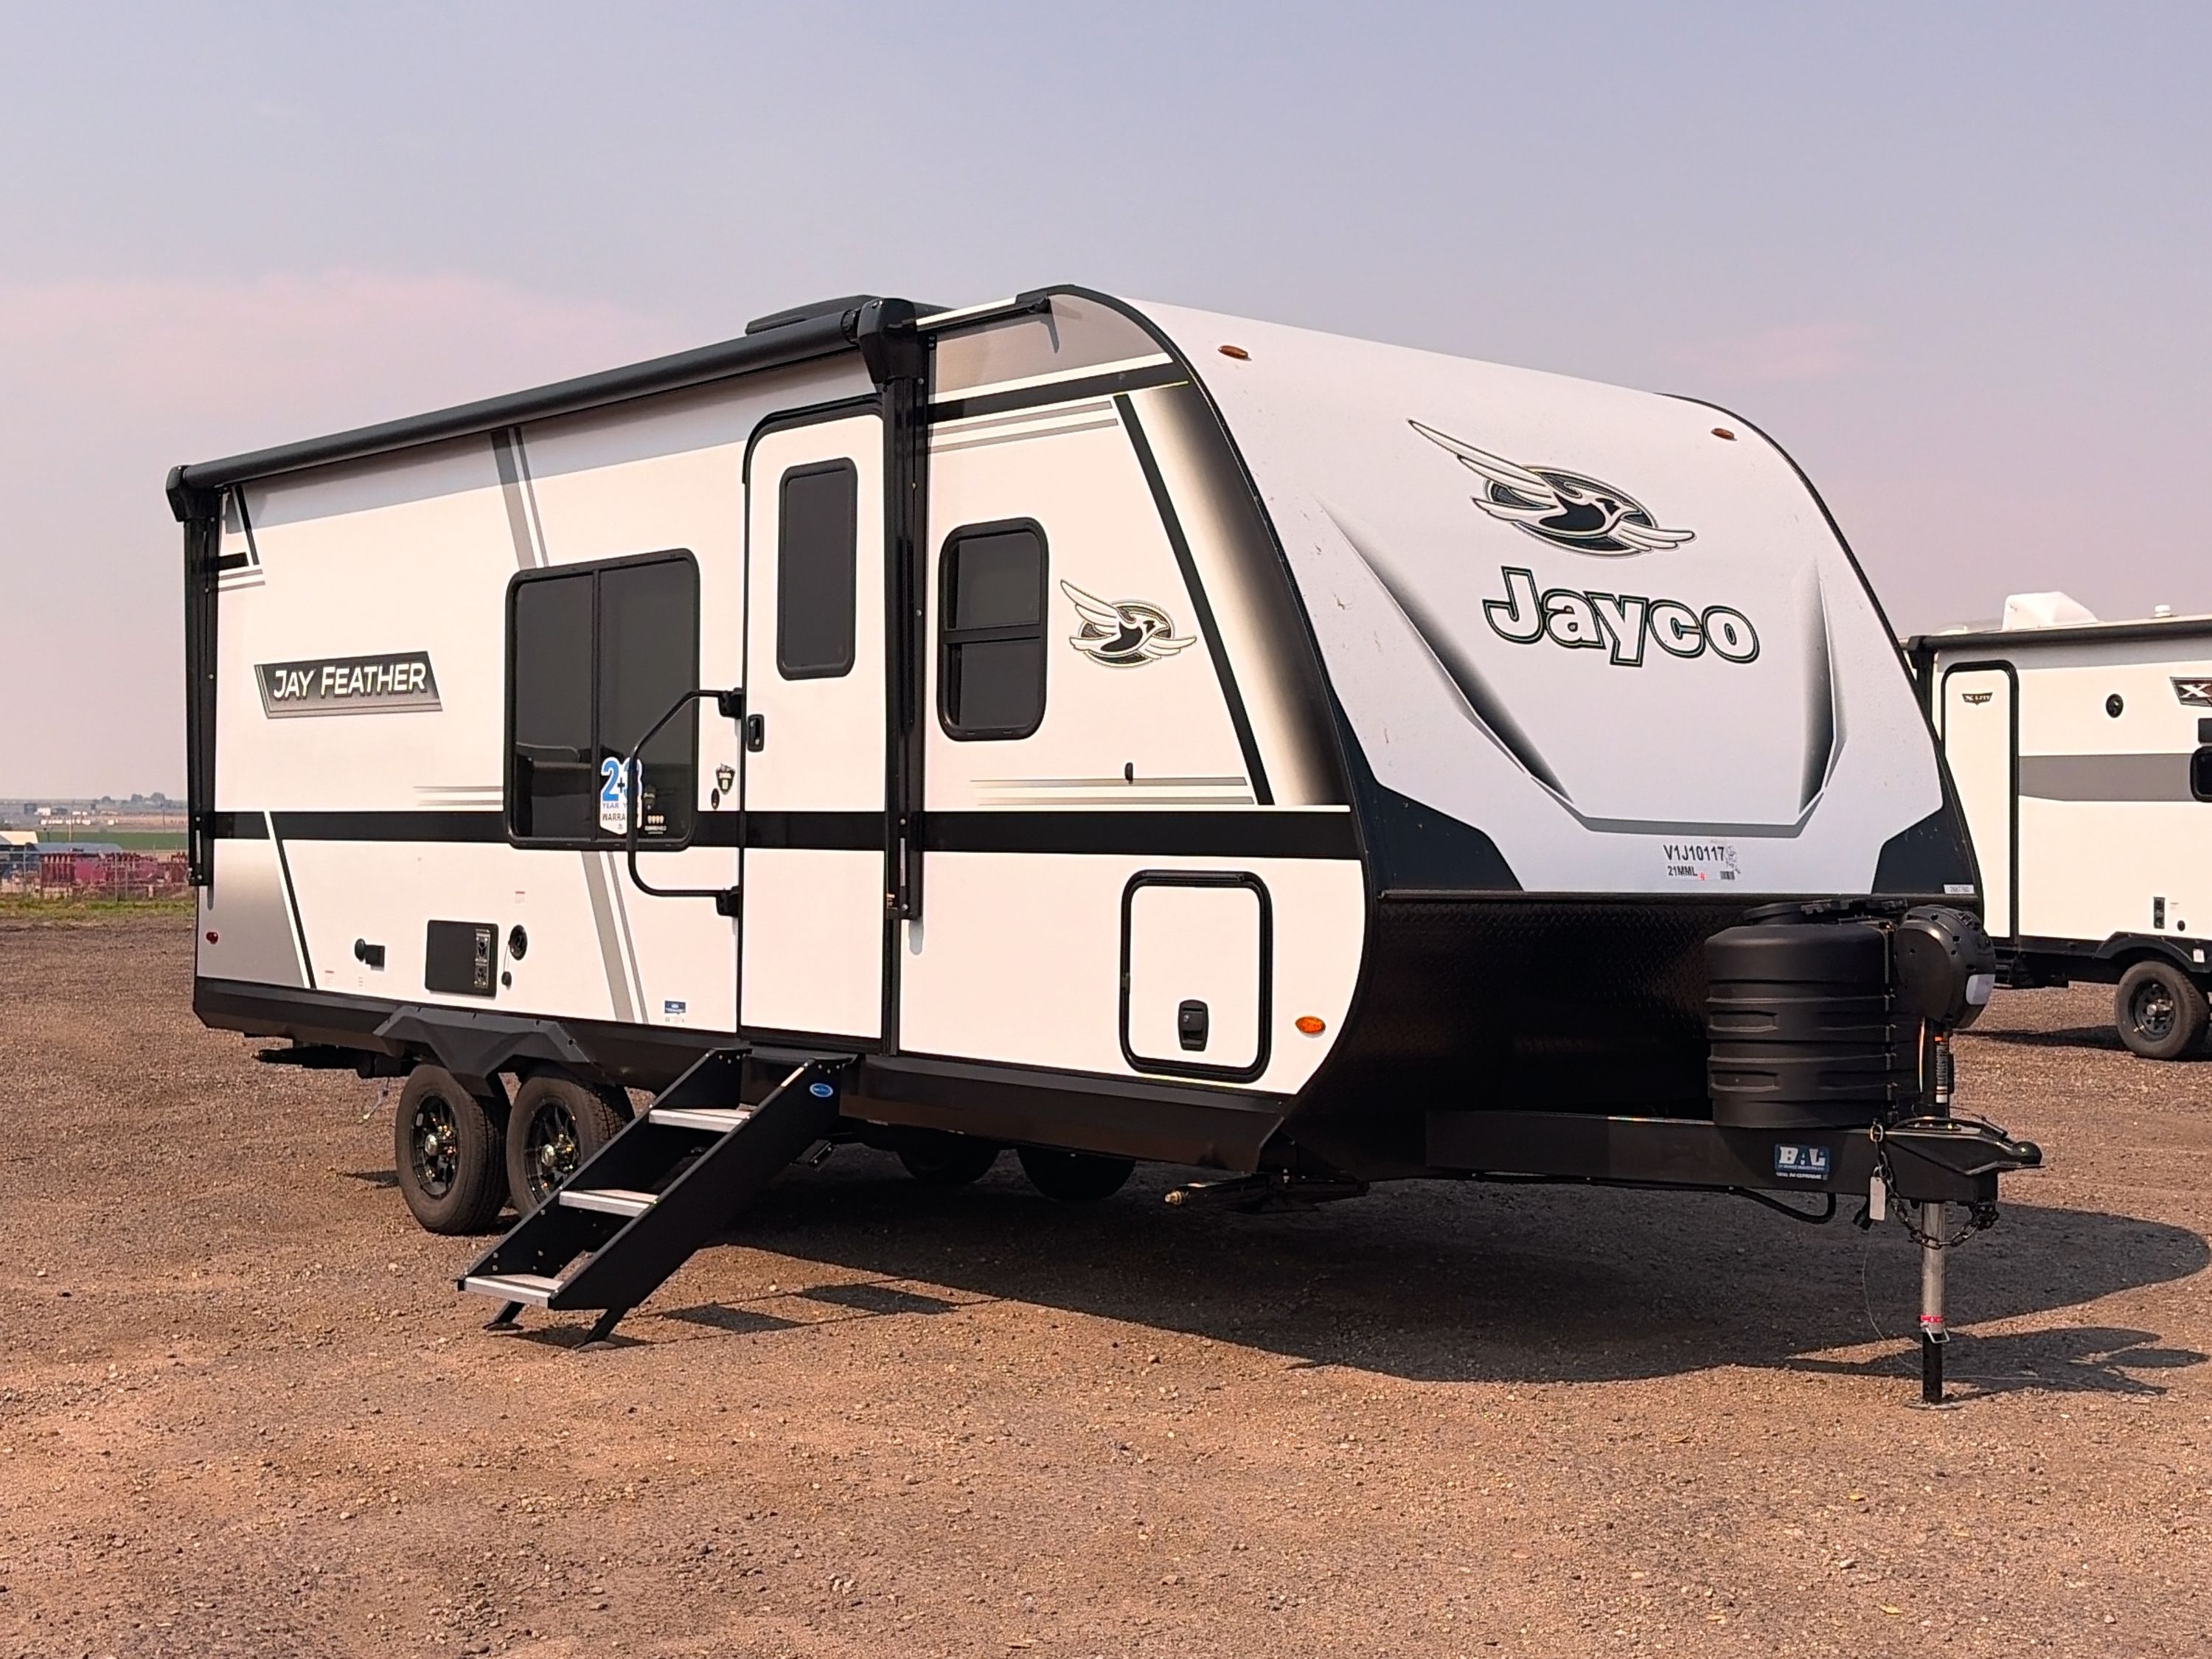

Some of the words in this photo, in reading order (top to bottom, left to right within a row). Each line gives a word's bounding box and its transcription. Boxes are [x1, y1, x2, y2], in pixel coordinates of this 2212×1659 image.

[1482, 566, 1760, 667] Jayco
[274, 669, 316, 700] JAY
[320, 663, 427, 698] FEATHER
[1663, 844, 1725, 861] V1J10117
